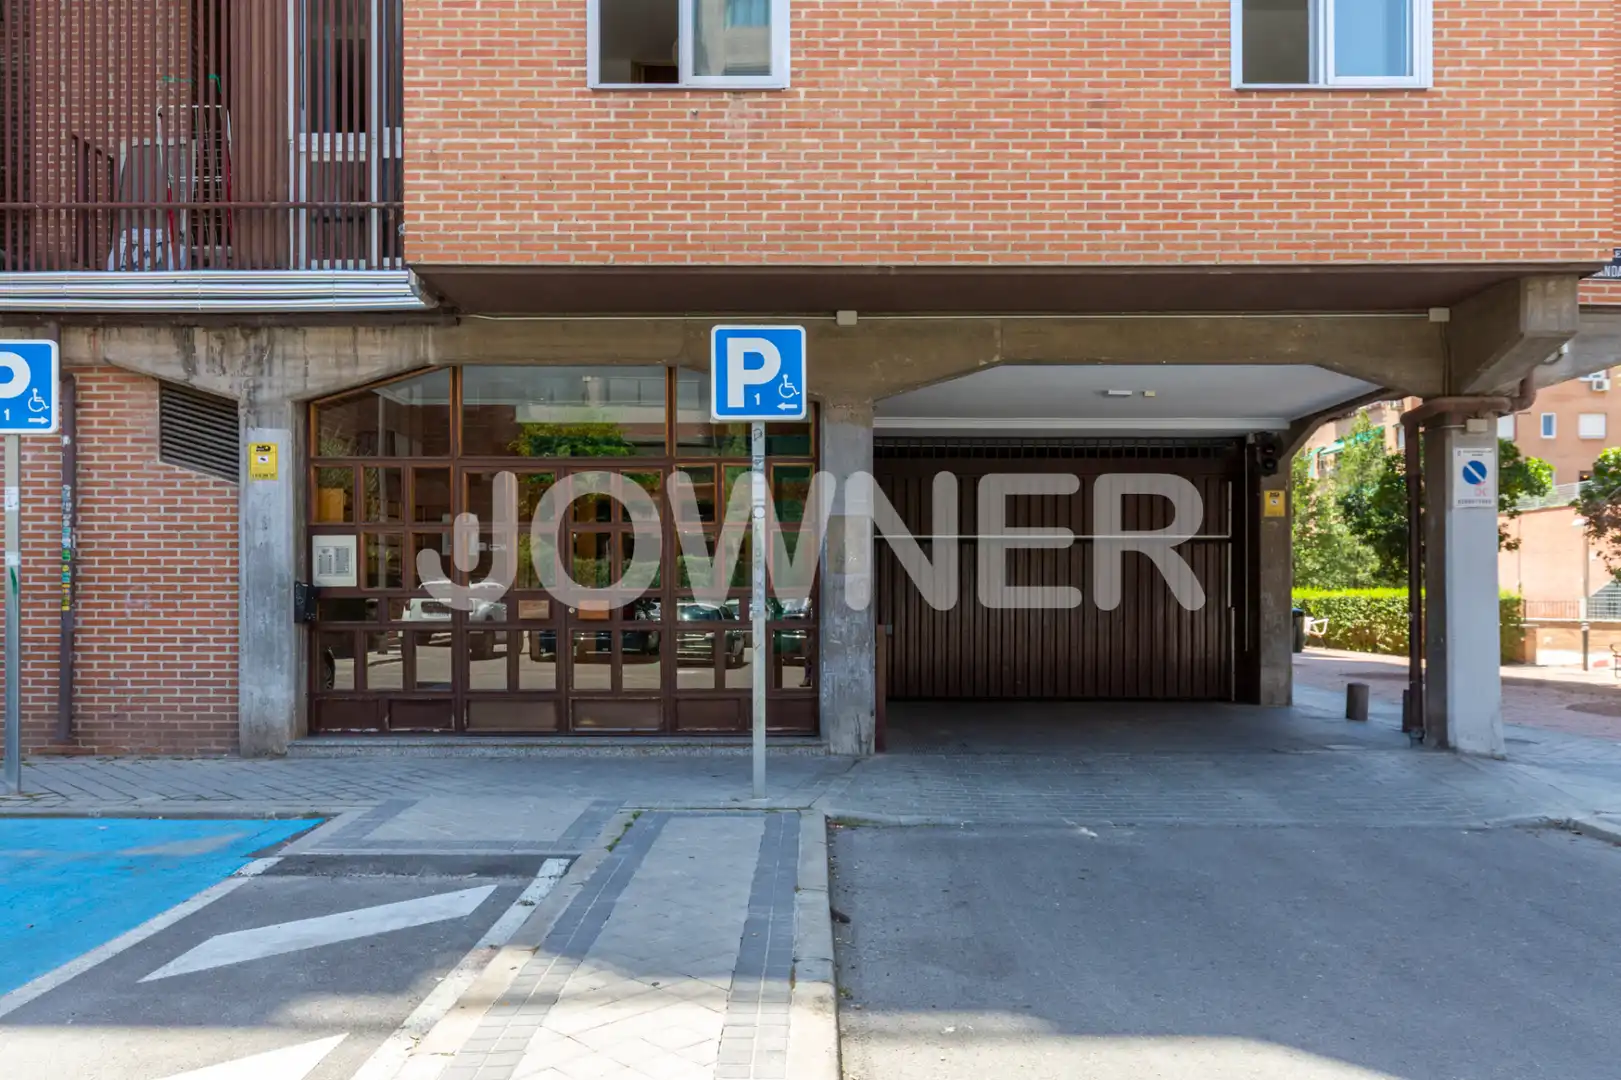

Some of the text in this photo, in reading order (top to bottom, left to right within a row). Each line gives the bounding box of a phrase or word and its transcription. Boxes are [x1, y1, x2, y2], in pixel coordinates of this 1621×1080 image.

[727, 337, 781, 408] P
[754, 392, 760, 406] 1
[4, 408, 10, 421] 1
